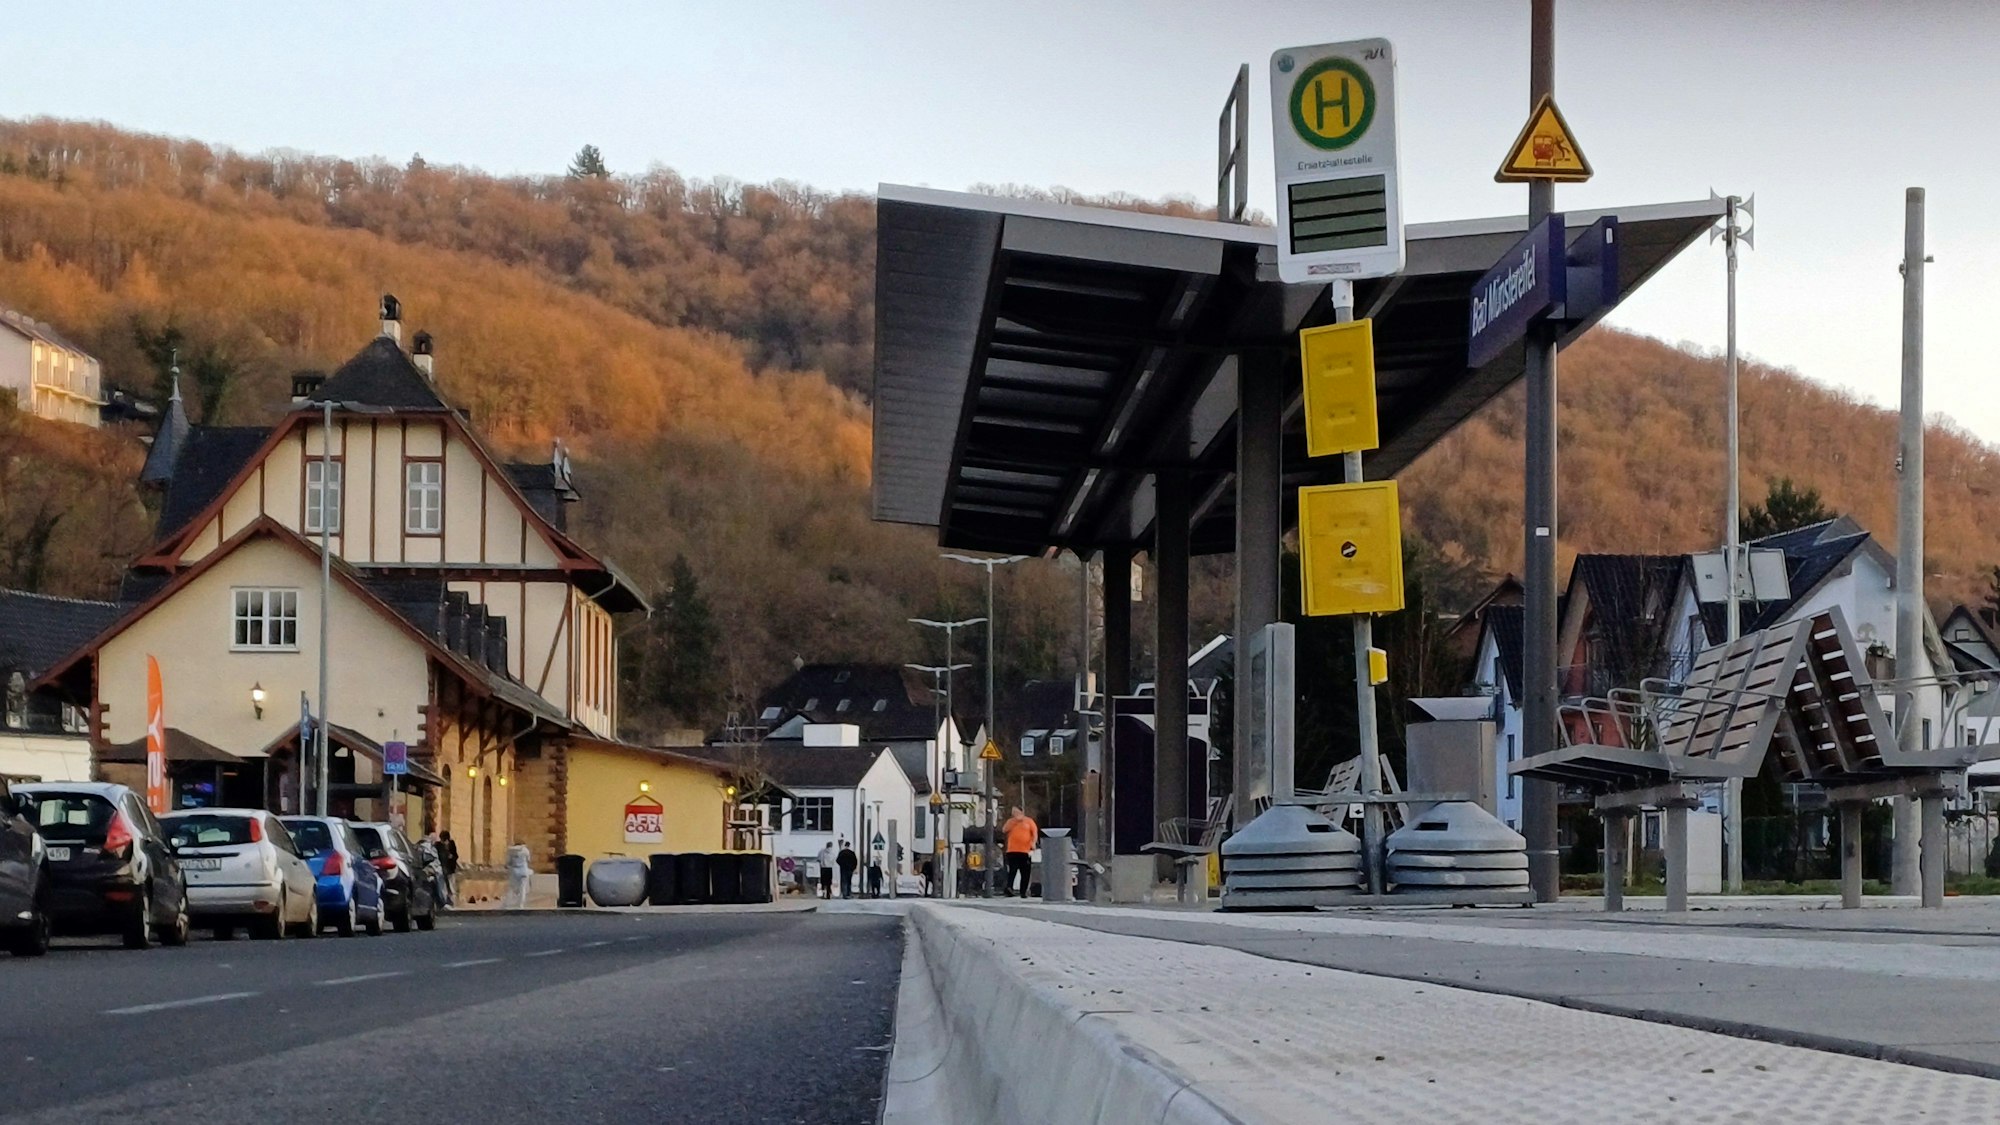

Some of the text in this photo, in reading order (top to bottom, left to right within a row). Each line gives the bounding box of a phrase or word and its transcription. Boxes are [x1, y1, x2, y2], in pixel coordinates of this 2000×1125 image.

[1315, 78, 1350, 129] H
[1472, 244, 1536, 337] Bad Münstereifel
[625, 824, 662, 833] COLA
